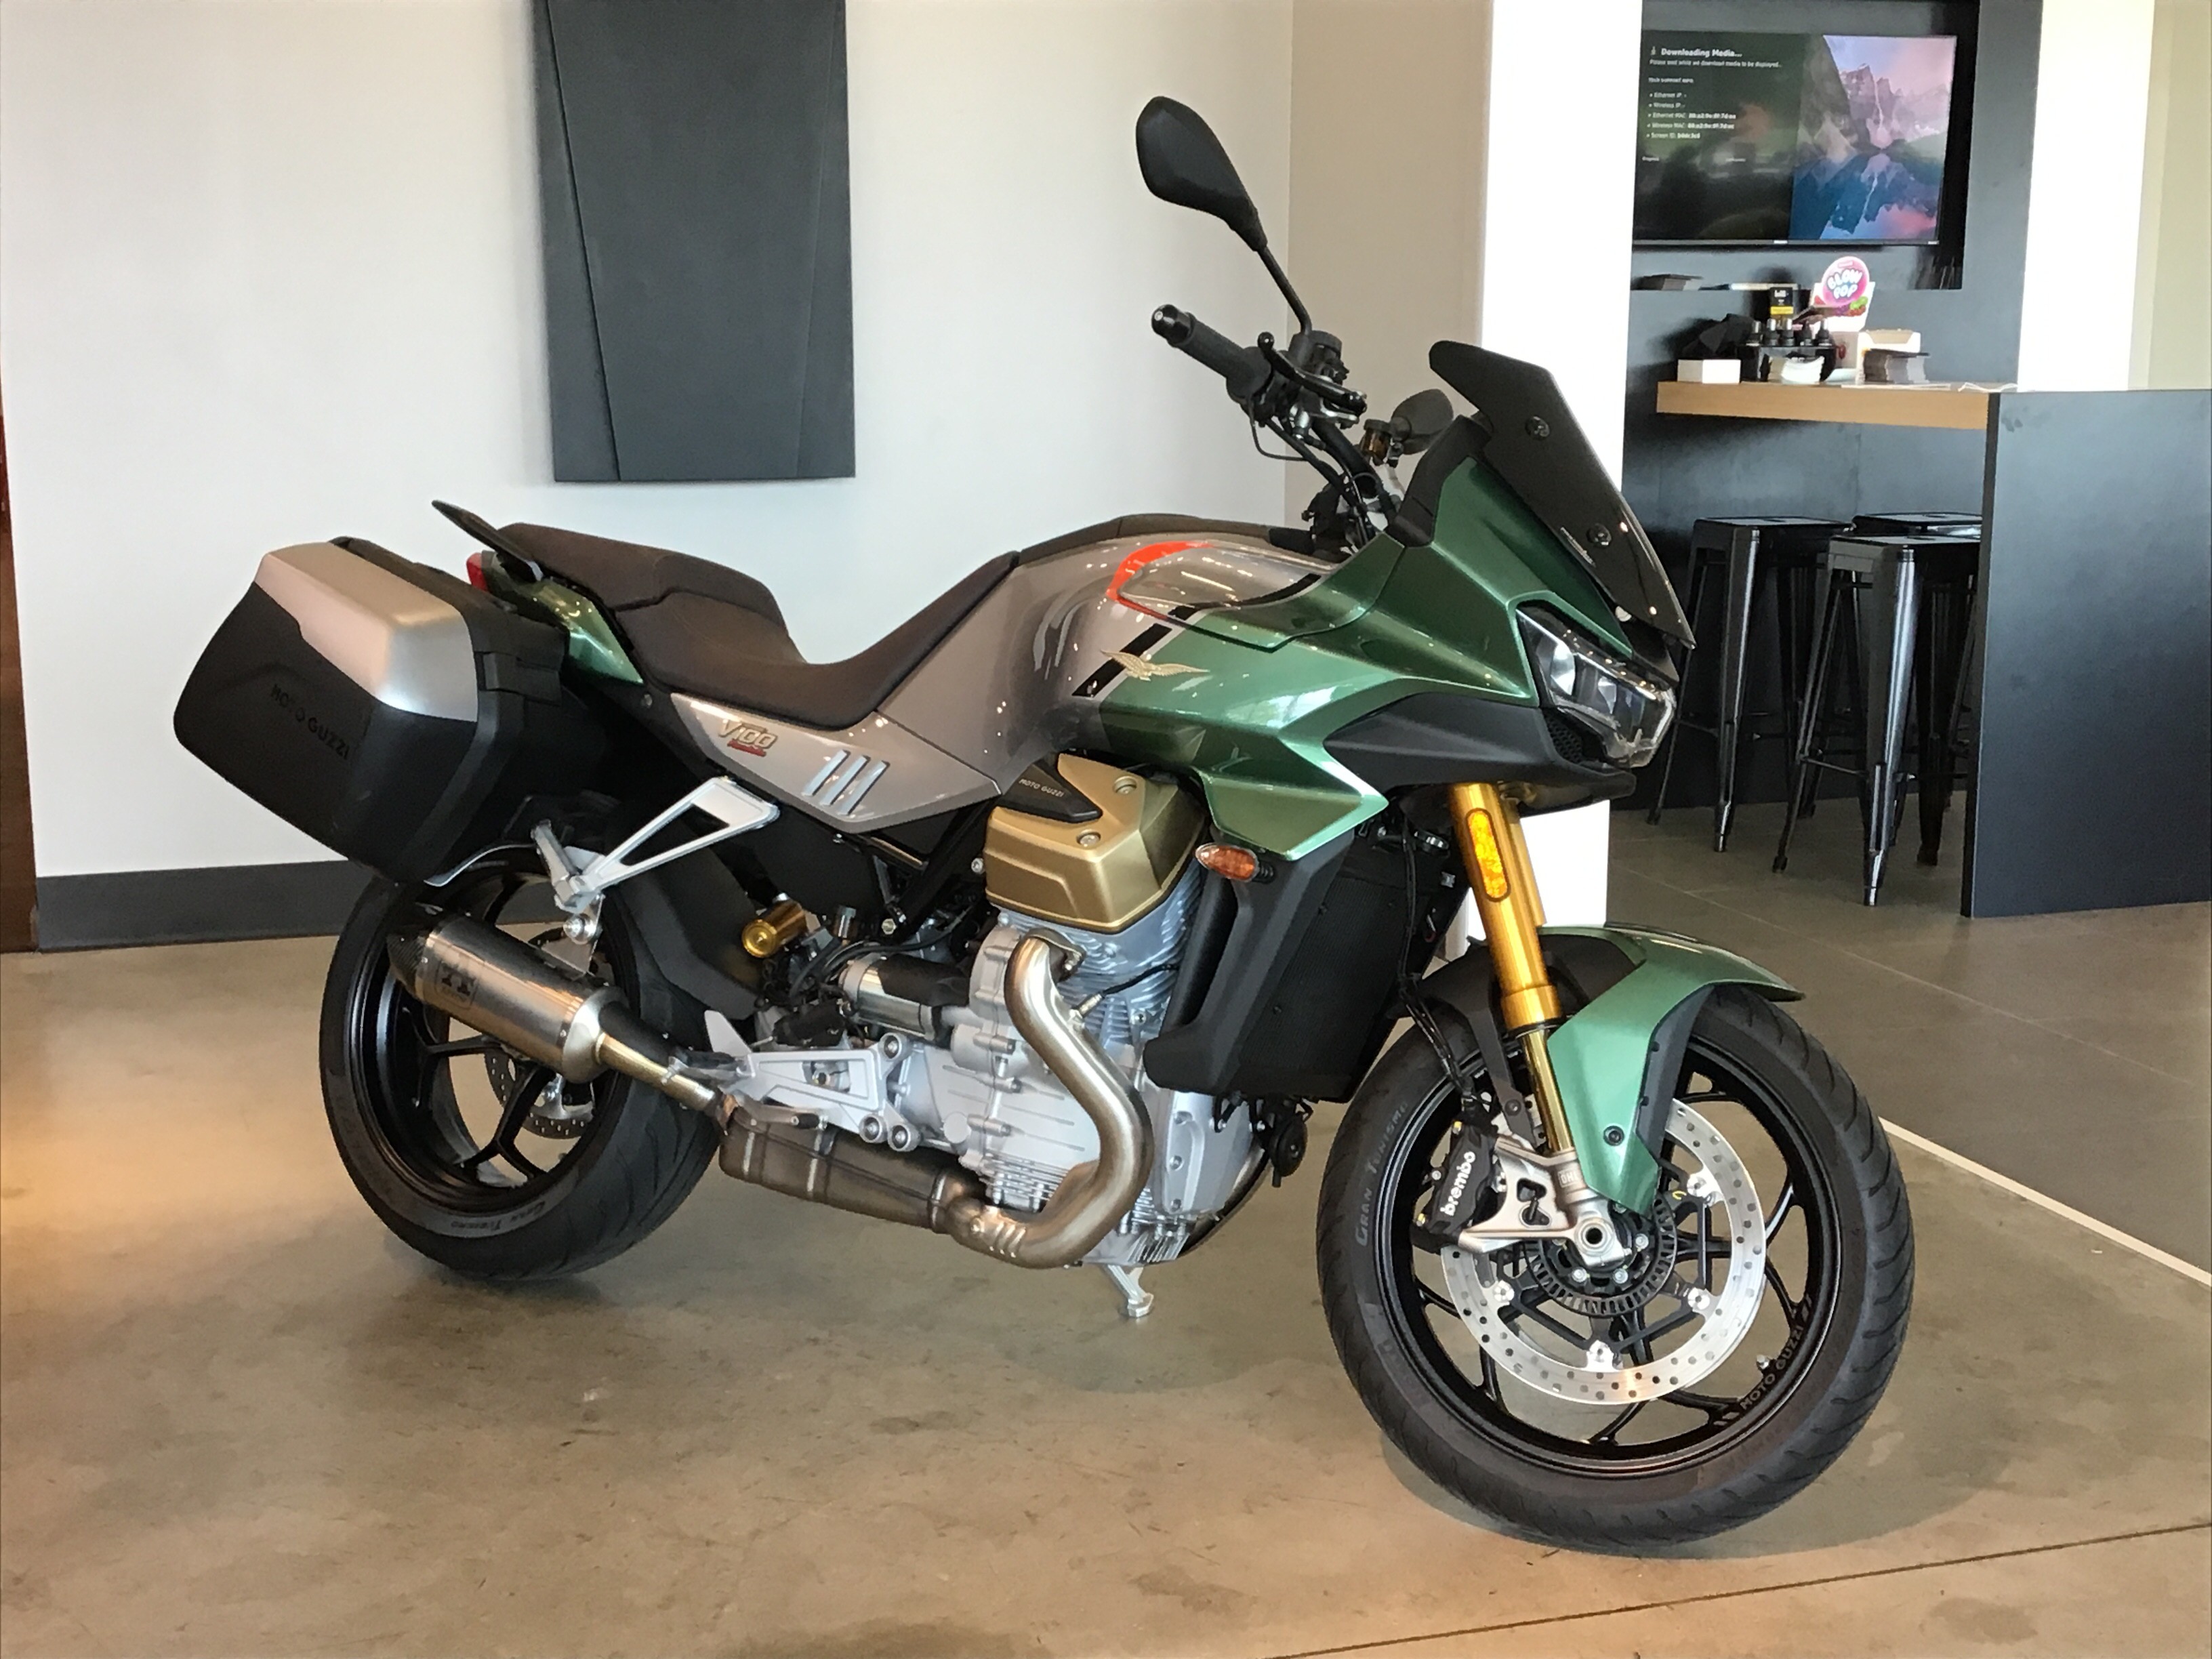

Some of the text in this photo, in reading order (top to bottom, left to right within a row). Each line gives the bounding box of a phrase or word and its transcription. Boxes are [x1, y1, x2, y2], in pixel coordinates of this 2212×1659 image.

[1661, 48, 1710, 58] Downloading
[1827, 269, 1862, 290] BLOW
[1833, 284, 1858, 300] POP
[271, 683, 306, 723] MOO
[718, 719, 778, 750] V100
[1019, 779, 1065, 798] MOTO GUZZI
[1439, 1151, 1476, 1217] brembo
[1740, 1325, 1804, 1410] MOTO GUZZI
